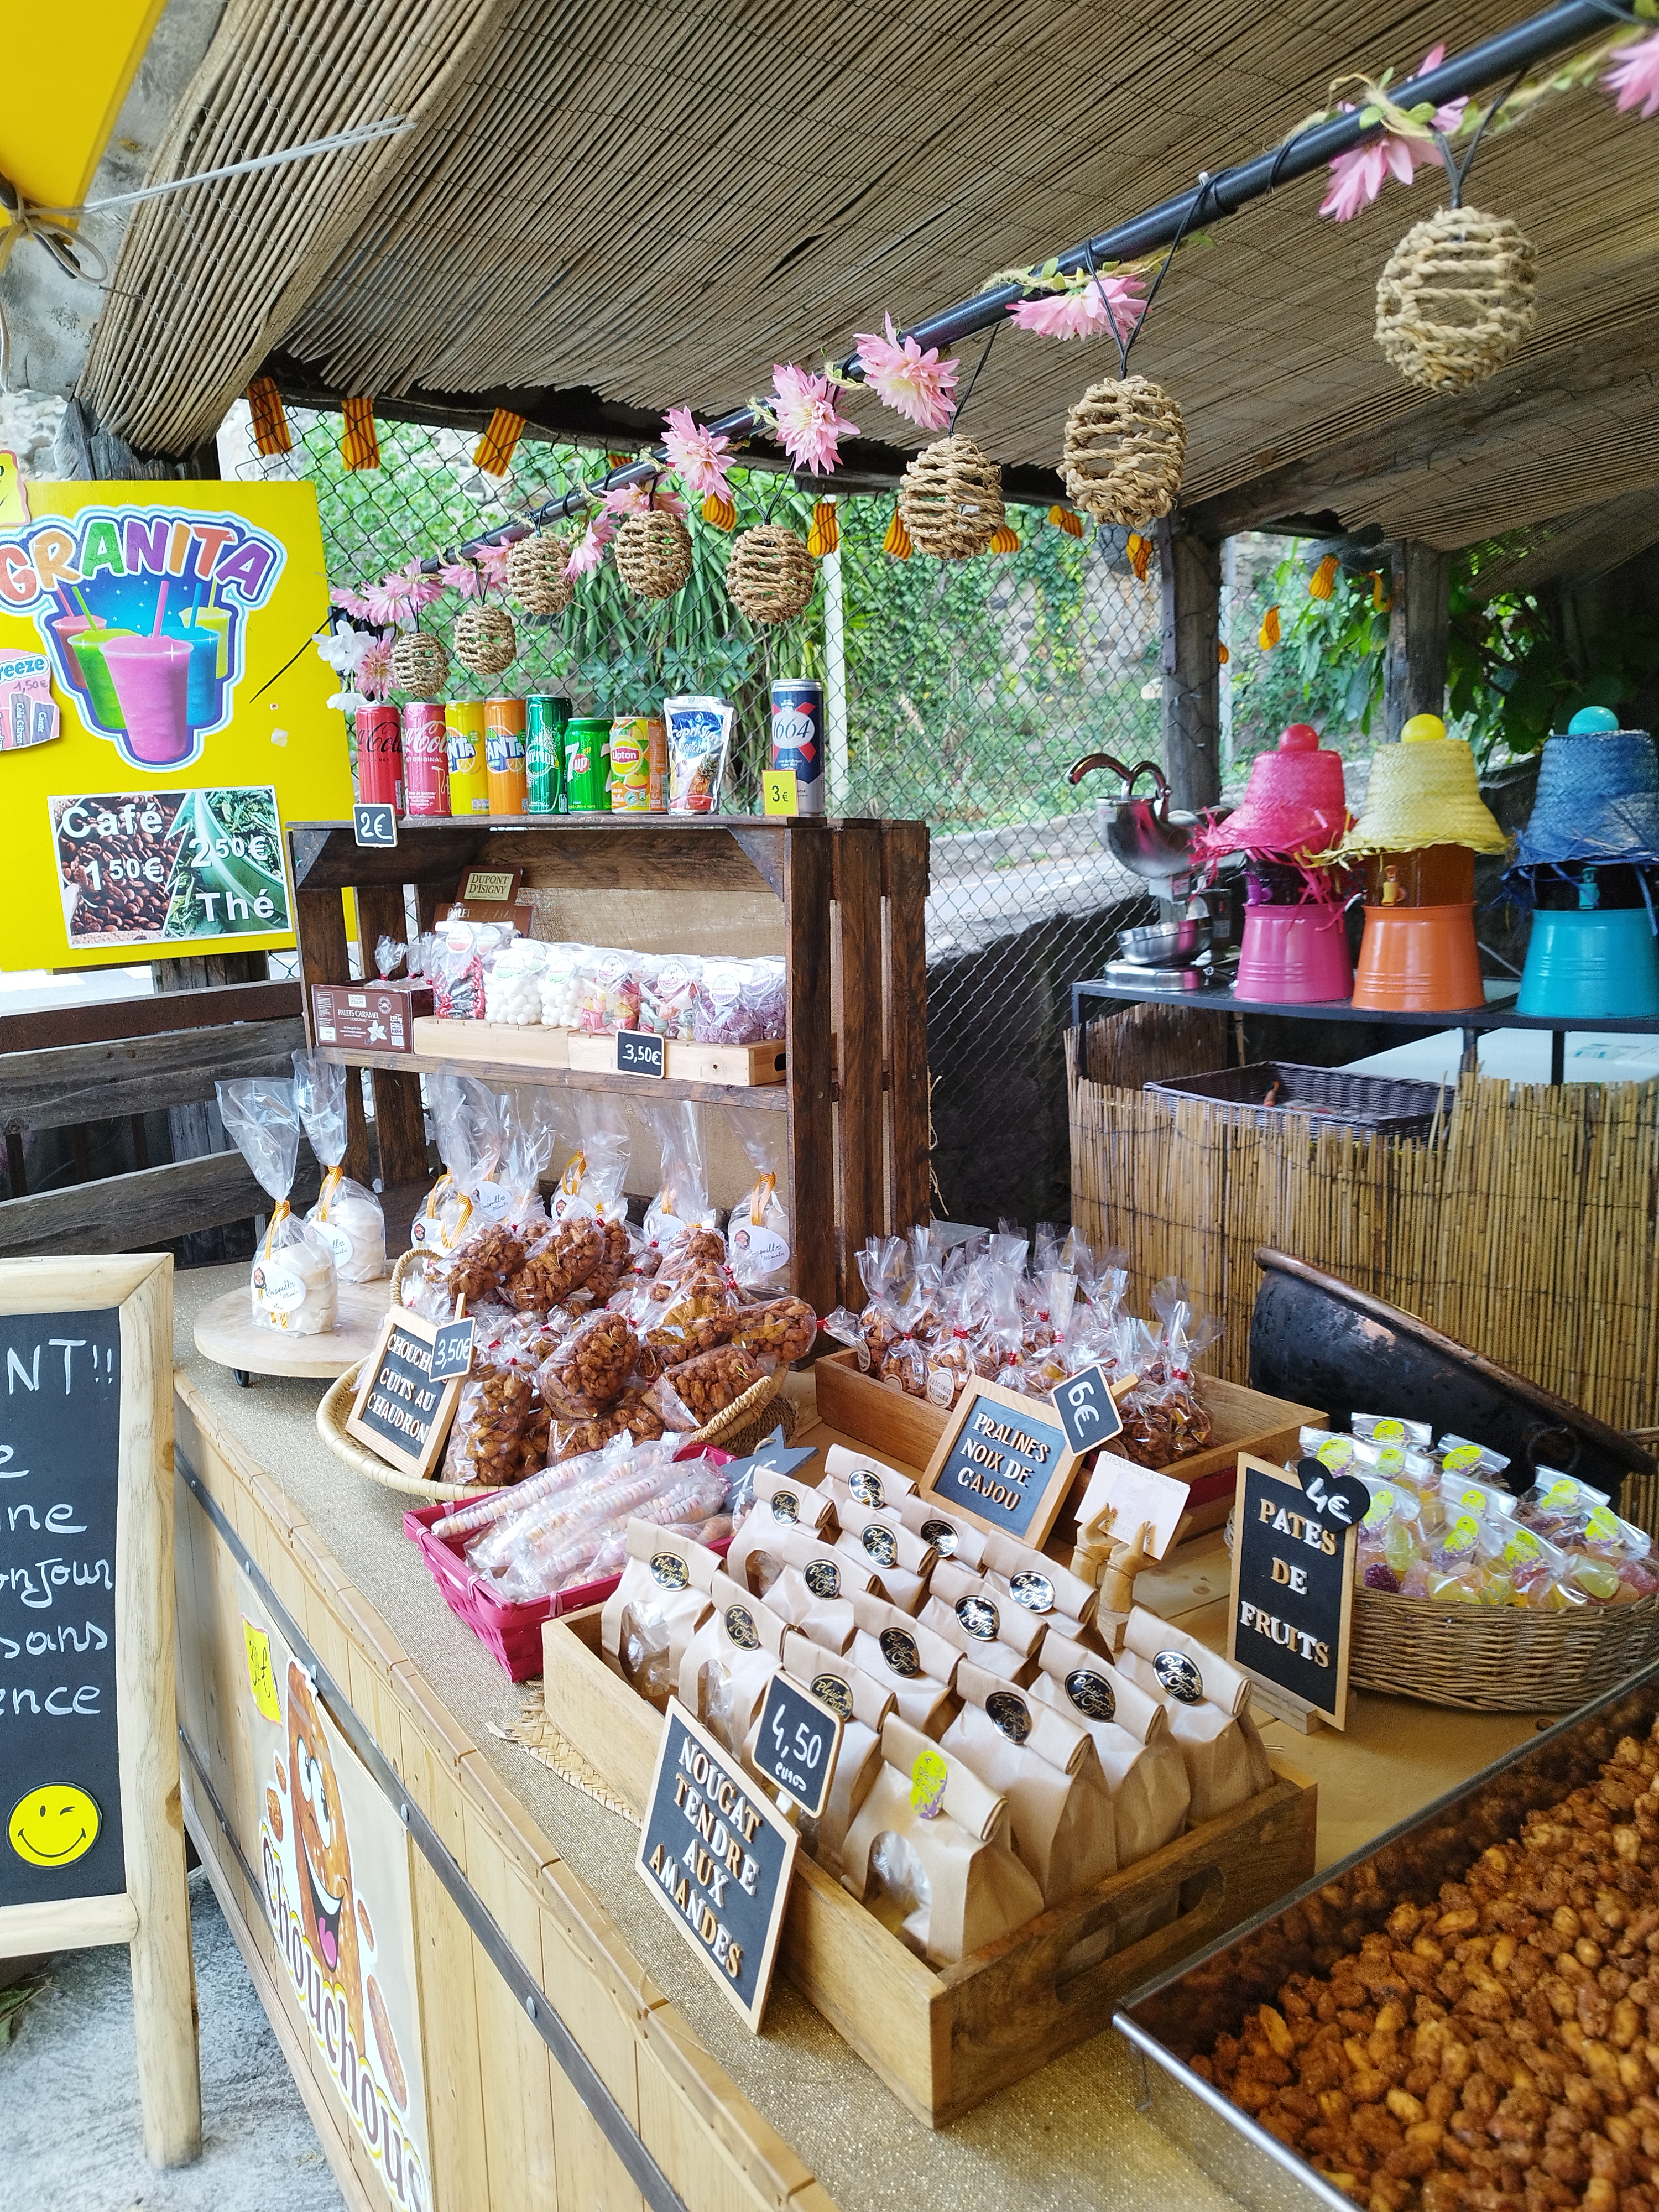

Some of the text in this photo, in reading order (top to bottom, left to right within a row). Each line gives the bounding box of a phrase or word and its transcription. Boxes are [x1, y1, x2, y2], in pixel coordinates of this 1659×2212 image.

[0, 521, 270, 601] GRANITA
[13, 680, 48, 693] 1,50€
[774, 717, 810, 739] 1664
[486, 735, 525, 761] ANTA
[612, 750, 637, 761] Lipton
[62, 803, 163, 838] Café
[360, 812, 393, 840] 2€
[471, 874, 509, 884] DUPONT
[195, 888, 275, 922] Thé
[355, 1010, 380, 1019] CARAMEL
[623, 1044, 661, 1065] 3,50€
[435, 1338, 470, 1370] 3,50€
[380, 1368, 437, 1411] CUITS AU
[367, 1392, 431, 1444] CHAUDRON
[1068, 1381, 1100, 1438] 6€
[972, 1412, 1051, 1464] PRALINES
[960, 1437, 1033, 1488] NOIX DE
[1105, 1454, 1145, 1477] CHOUCHOU
[1145, 1472, 1155, 1481] LA
[1156, 1476, 1187, 1496] PRALINE
[958, 1467, 1021, 1511] CAJOU
[1306, 1477, 1352, 1524] 4€
[1258, 1498, 1337, 1556] PATES
[655, 1557, 681, 1573] Plaisir
[1271, 1557, 1308, 1595] DE
[1016, 1576, 1045, 1593] Plaisir
[729, 1610, 752, 1629] Plaisir
[1239, 1600, 1330, 1668] FRUITS
[886, 1632, 913, 1653] Plaisir
[1162, 1655, 1191, 1680] Plaisir
[816, 1680, 844, 1700] Plaisir
[1074, 1675, 1104, 1697] Plaisir
[772, 1704, 822, 1770] 4,50
[679, 1736, 763, 1843] NOUGAT
[775, 1762, 807, 1791] euros
[675, 1772, 759, 1896] TENDRE
[682, 1839, 729, 1908] AUX
[649, 1843, 743, 1978] AMANDES
